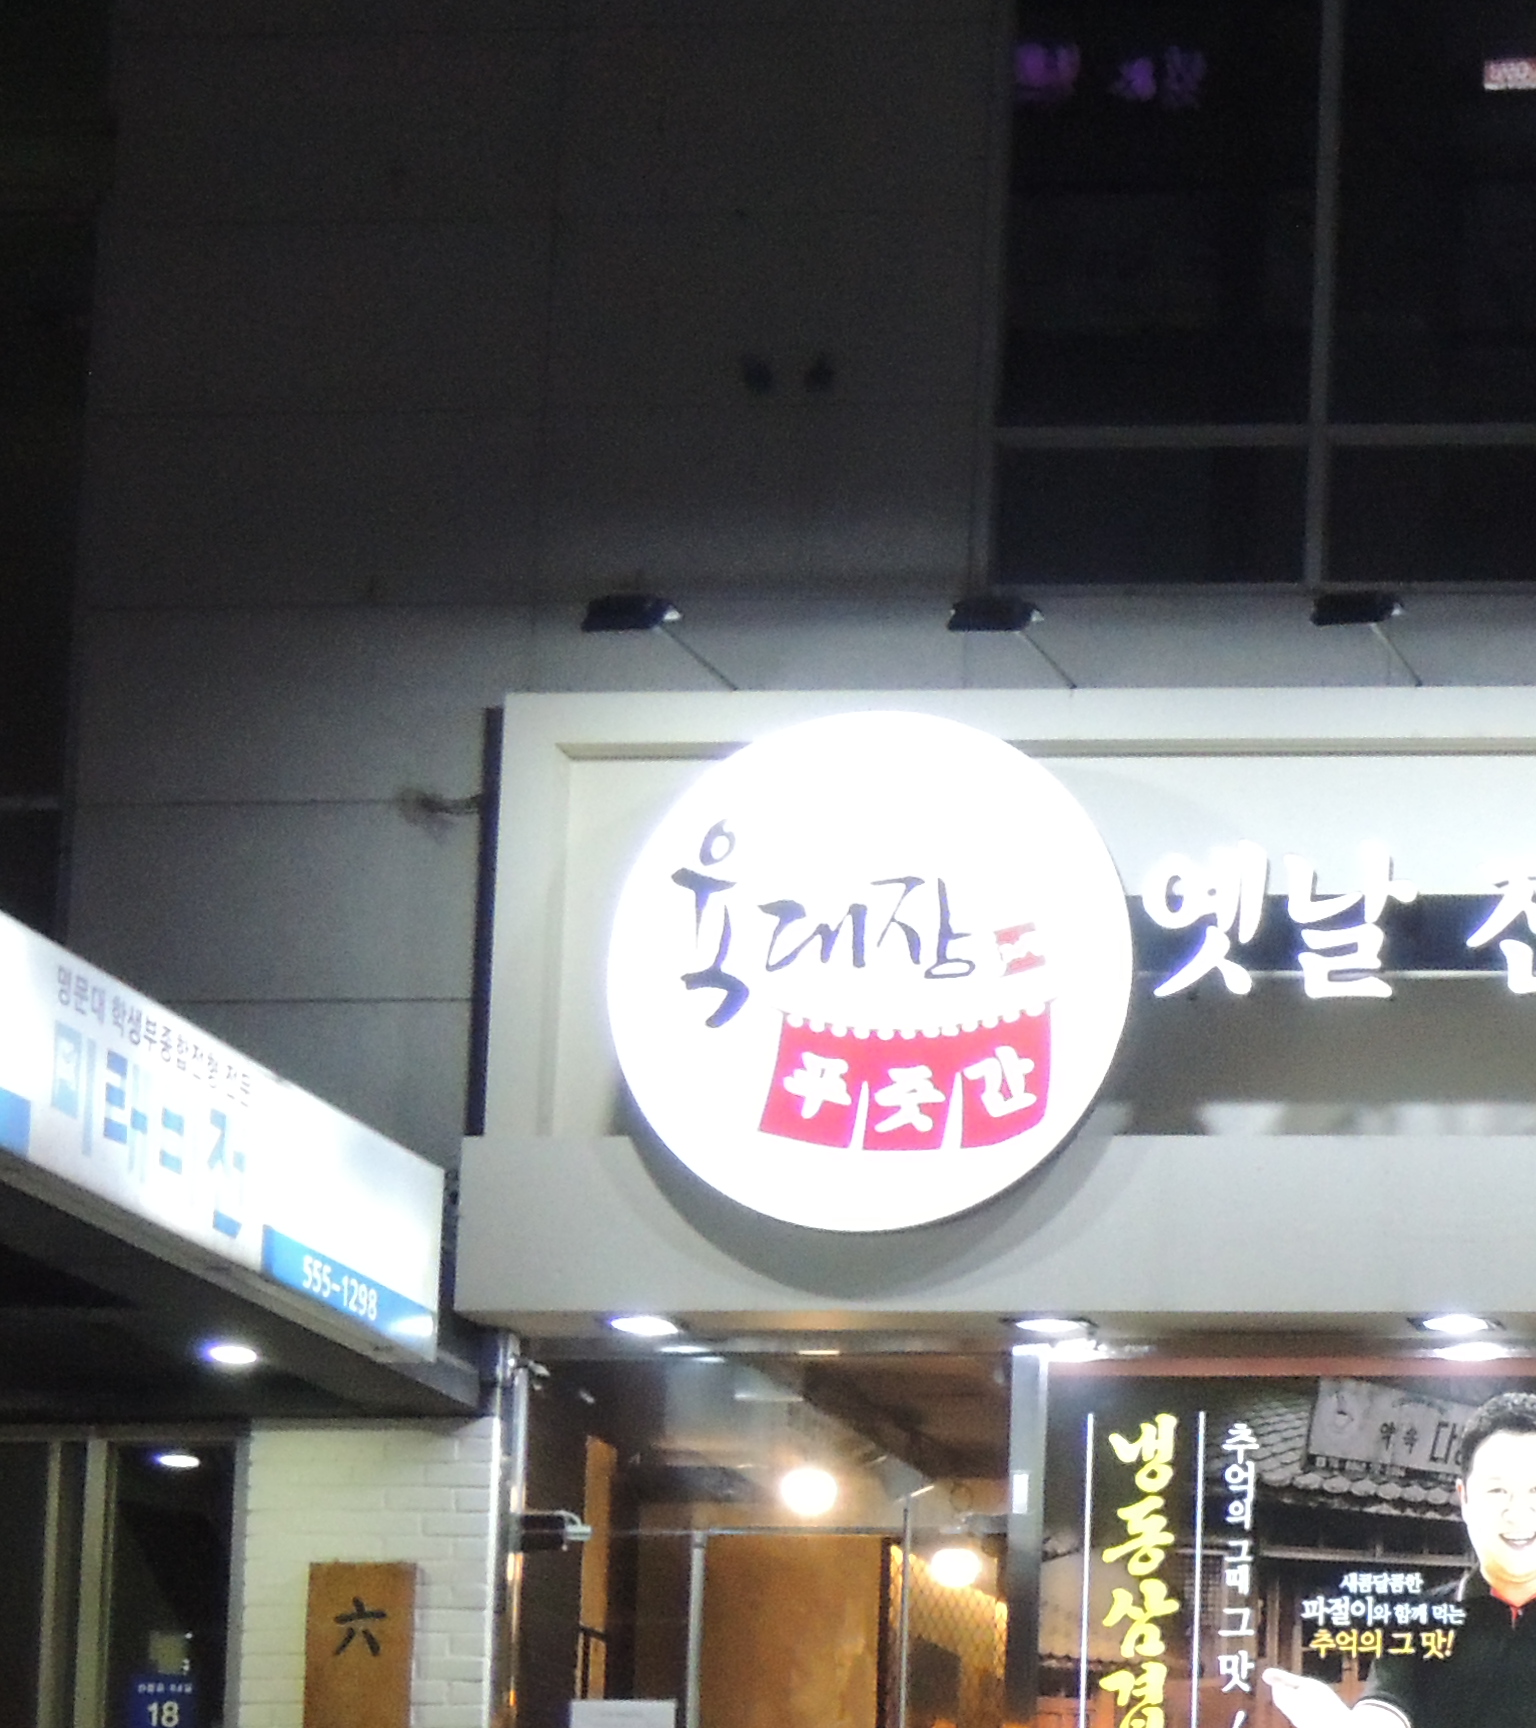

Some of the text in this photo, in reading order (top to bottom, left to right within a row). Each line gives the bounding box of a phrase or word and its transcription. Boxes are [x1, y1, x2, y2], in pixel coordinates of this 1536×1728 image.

[1141, 842, 1417, 1000] 옛날
[57, 964, 108, 1025] 명문대
[301, 1254, 379, 1323] 555-1298
[1220, 1423, 1260, 1530] 추억의
[1224, 1540, 1253, 1595] 그때
[1339, 1571, 1424, 1594] 새콤달콤한
[1217, 1605, 1256, 1637] 그
[1300, 1595, 1467, 1627] 파절이와 함께 먹는
[1309, 1628, 1456, 1660] 추억의 그 맛!
[147, 1700, 179, 1728] 18
